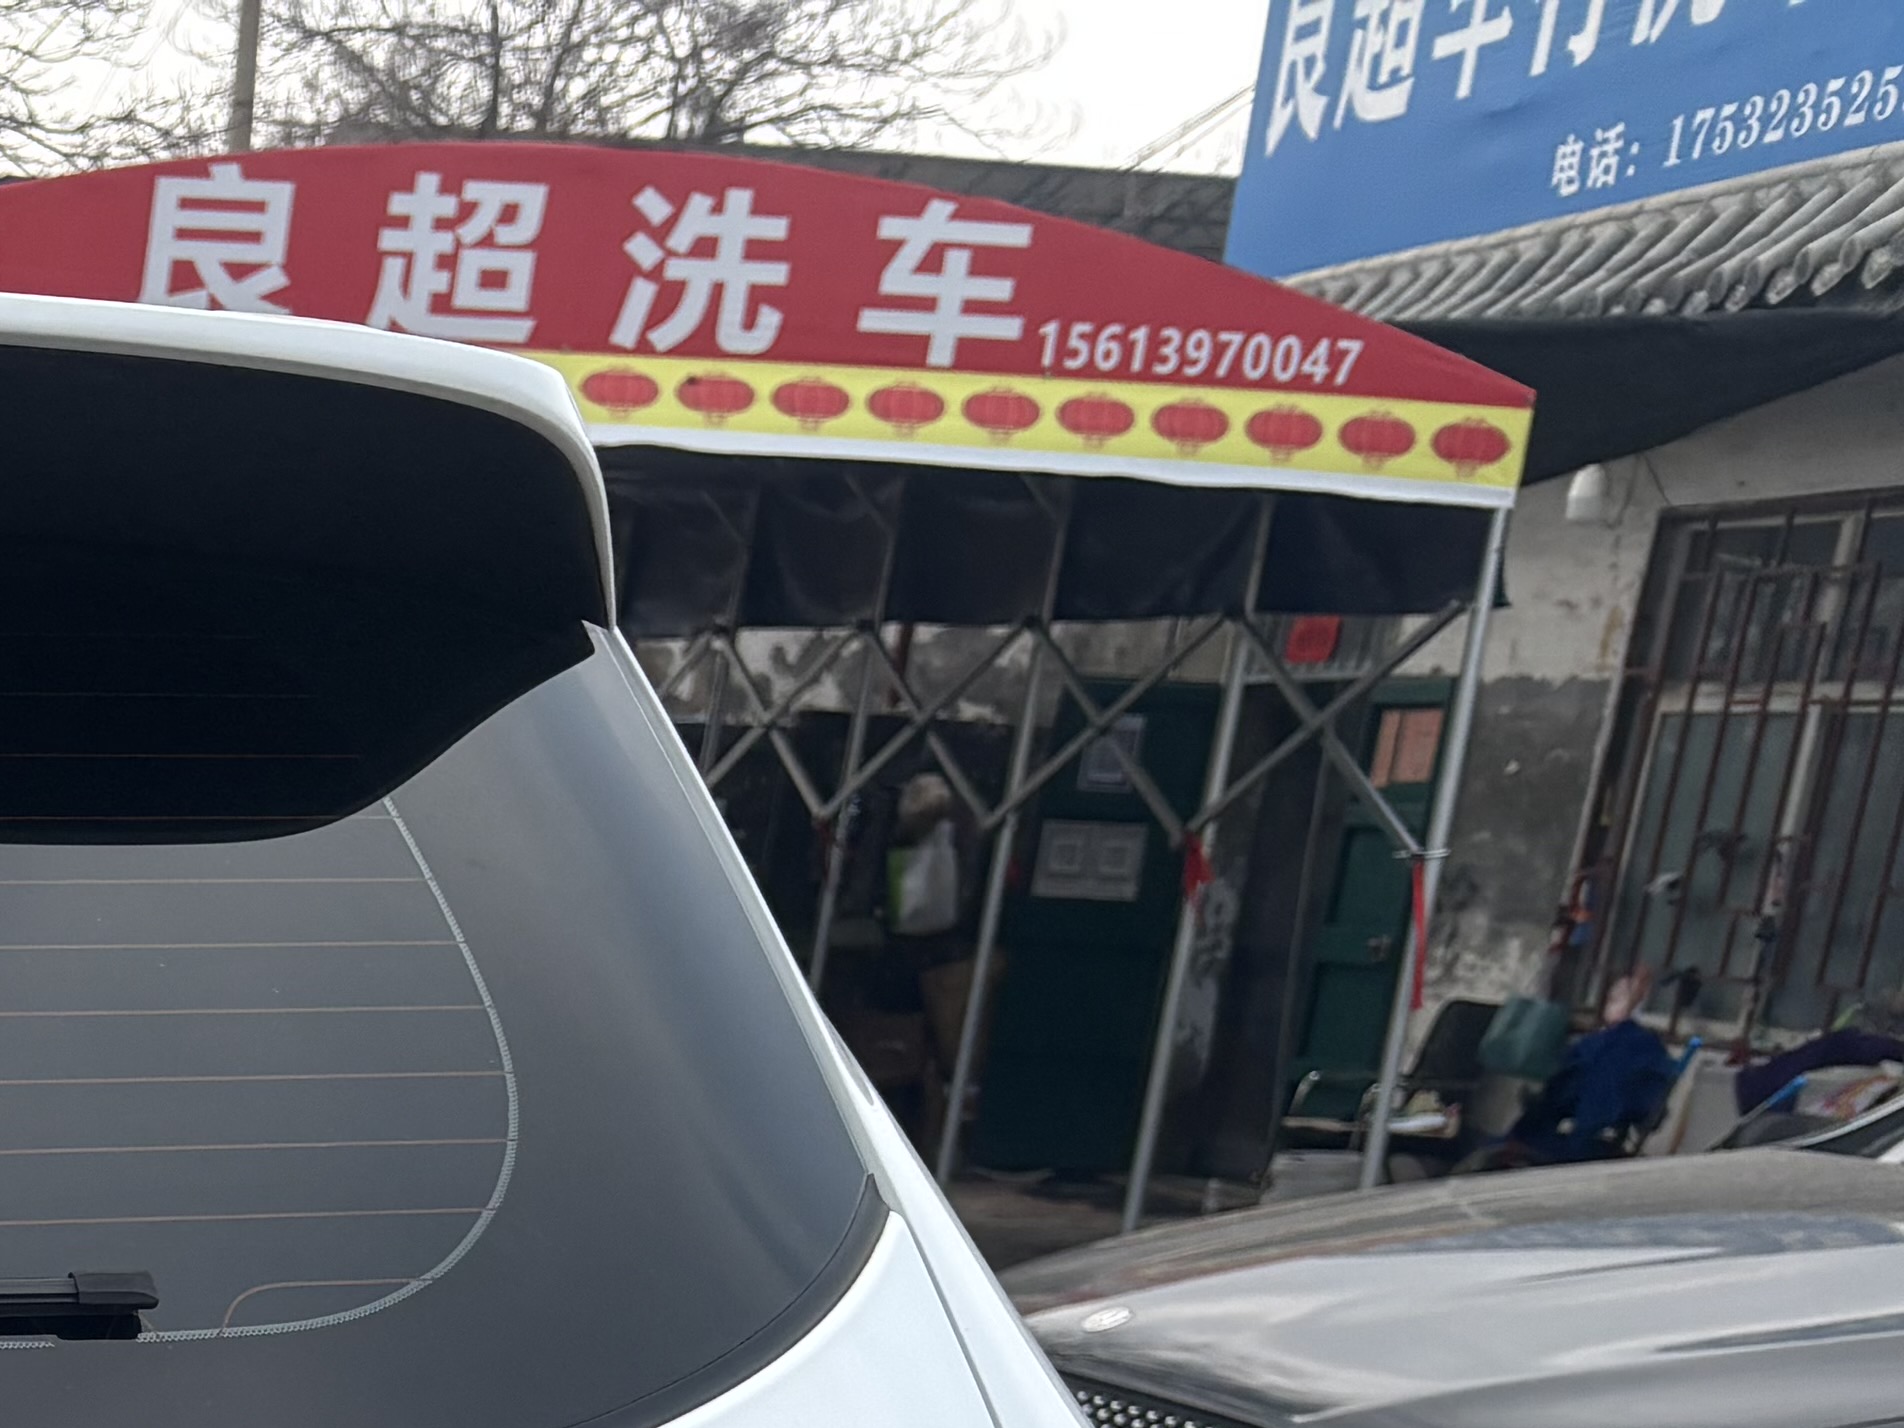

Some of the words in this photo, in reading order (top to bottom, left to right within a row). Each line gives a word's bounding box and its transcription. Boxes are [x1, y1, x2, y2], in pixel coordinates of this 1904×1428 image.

[1661, 64, 1904, 168] 175323525
[138, 162, 1038, 368] 良超洗车
[1037, 318, 1364, 388] 15613970047
